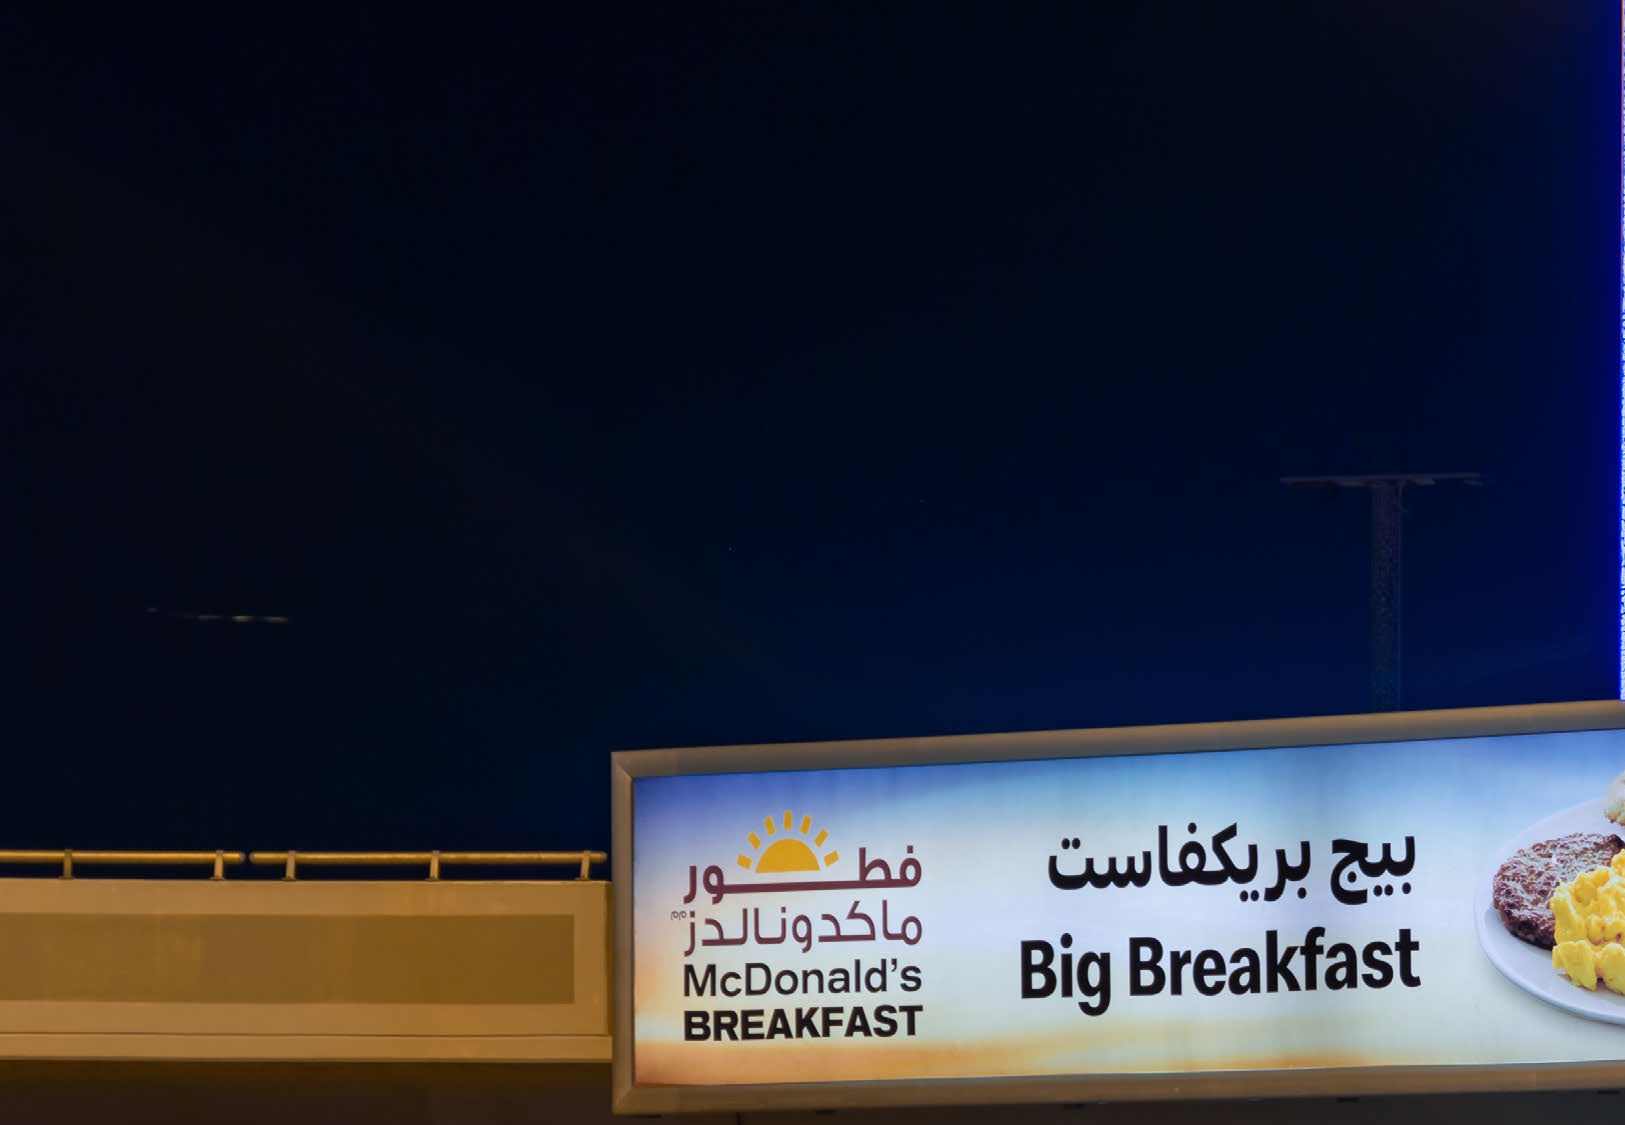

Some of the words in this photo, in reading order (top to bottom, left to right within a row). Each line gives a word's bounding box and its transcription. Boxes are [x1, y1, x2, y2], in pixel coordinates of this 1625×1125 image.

[683, 845, 922, 905] فطور
[1048, 822, 1311, 902] بريكفاست
[1331, 836, 1415, 905] بيج
[683, 899, 923, 957] ماكدونالدز
[683, 957, 922, 997] McDonald's
[1021, 932, 1111, 1017] Big
[1129, 926, 1421, 997] Breakfast
[683, 1004, 924, 1041] BREAKFAST
